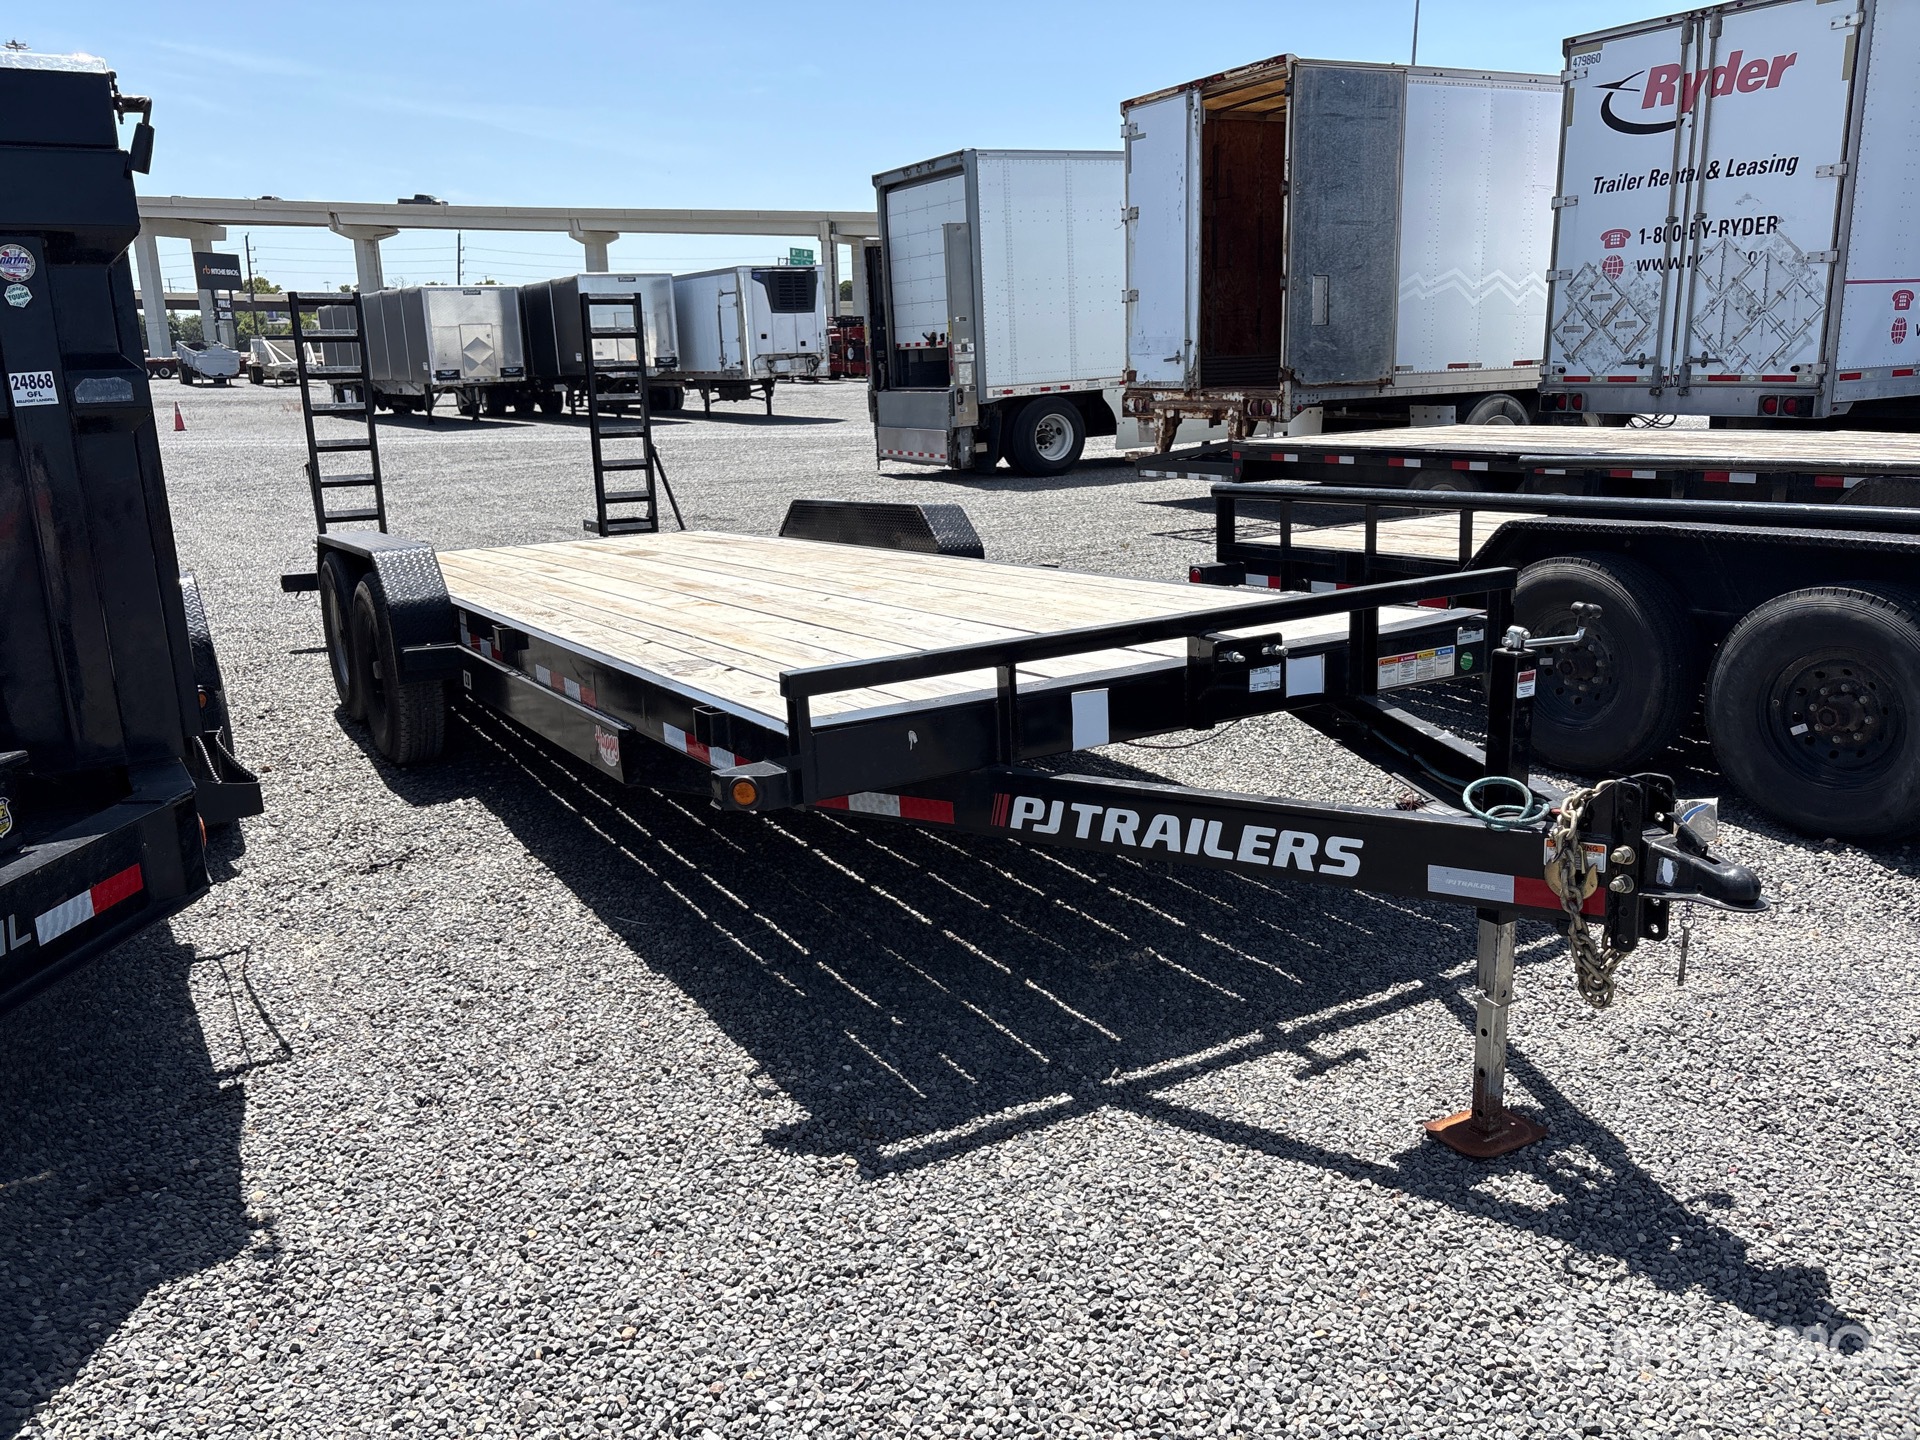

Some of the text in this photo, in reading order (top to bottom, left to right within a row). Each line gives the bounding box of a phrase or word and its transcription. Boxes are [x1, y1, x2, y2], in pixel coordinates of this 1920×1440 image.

[1572, 53, 1601, 67] 479860
[1641, 50, 1798, 113] Ryder
[1593, 154, 1799, 194] Trailer Rental & Leasing
[11, 373, 54, 391] 24868
[26, 390, 43, 398] GFL
[595, 724, 619, 762] Happy
[1009, 795, 1364, 878] PJ TRAILERS
